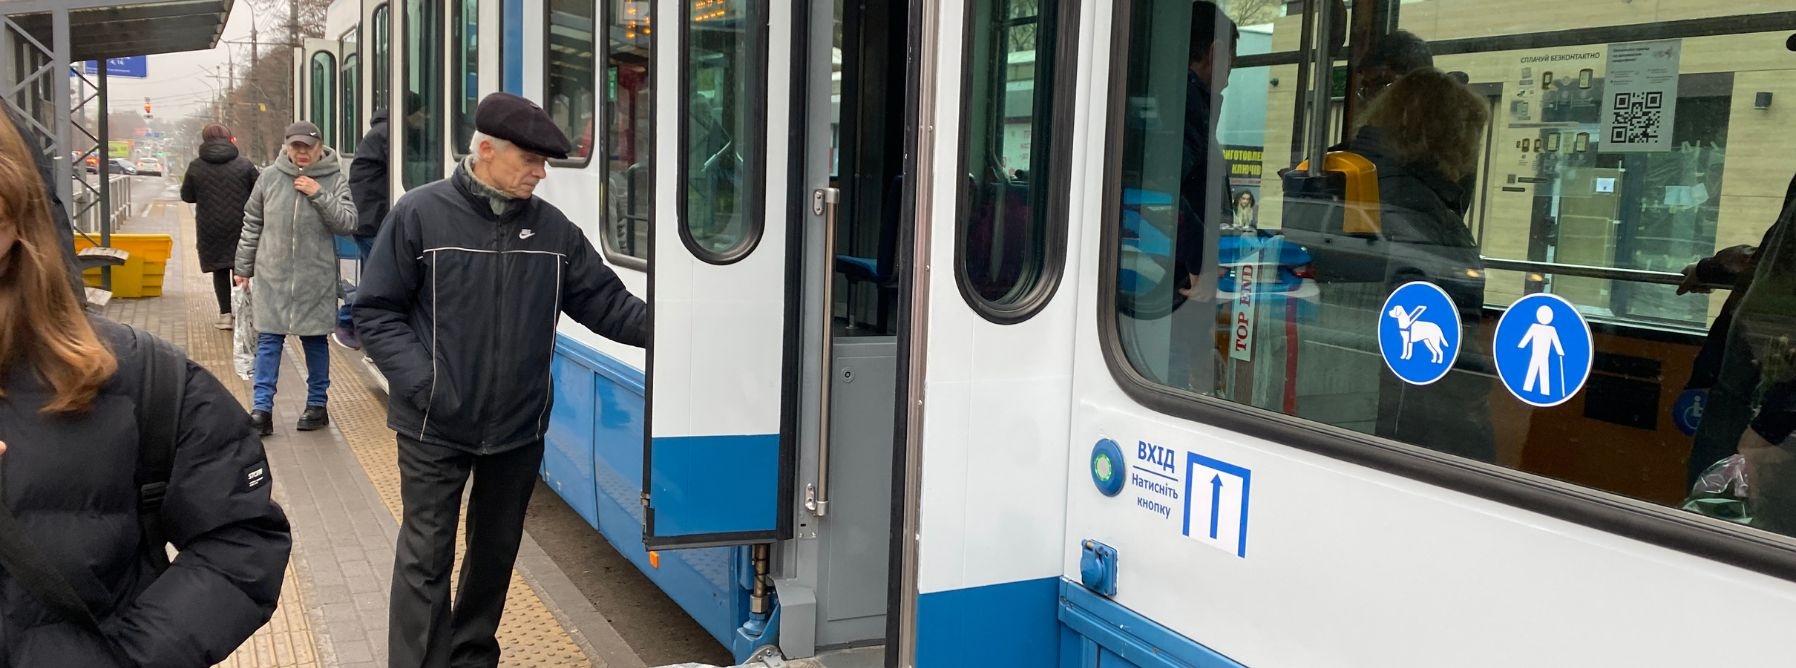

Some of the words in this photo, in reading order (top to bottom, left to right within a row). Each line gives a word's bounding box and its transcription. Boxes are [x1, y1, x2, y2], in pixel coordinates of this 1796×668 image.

[1551, 52, 1601, 62] БЕЗКОНТАКТНО
[1239, 264, 1254, 307] END
[1235, 311, 1250, 352] TOP
[1137, 440, 1175, 473] ВХІД
[1131, 473, 1178, 499] Натисніть
[1137, 496, 1171, 519] кнопку
